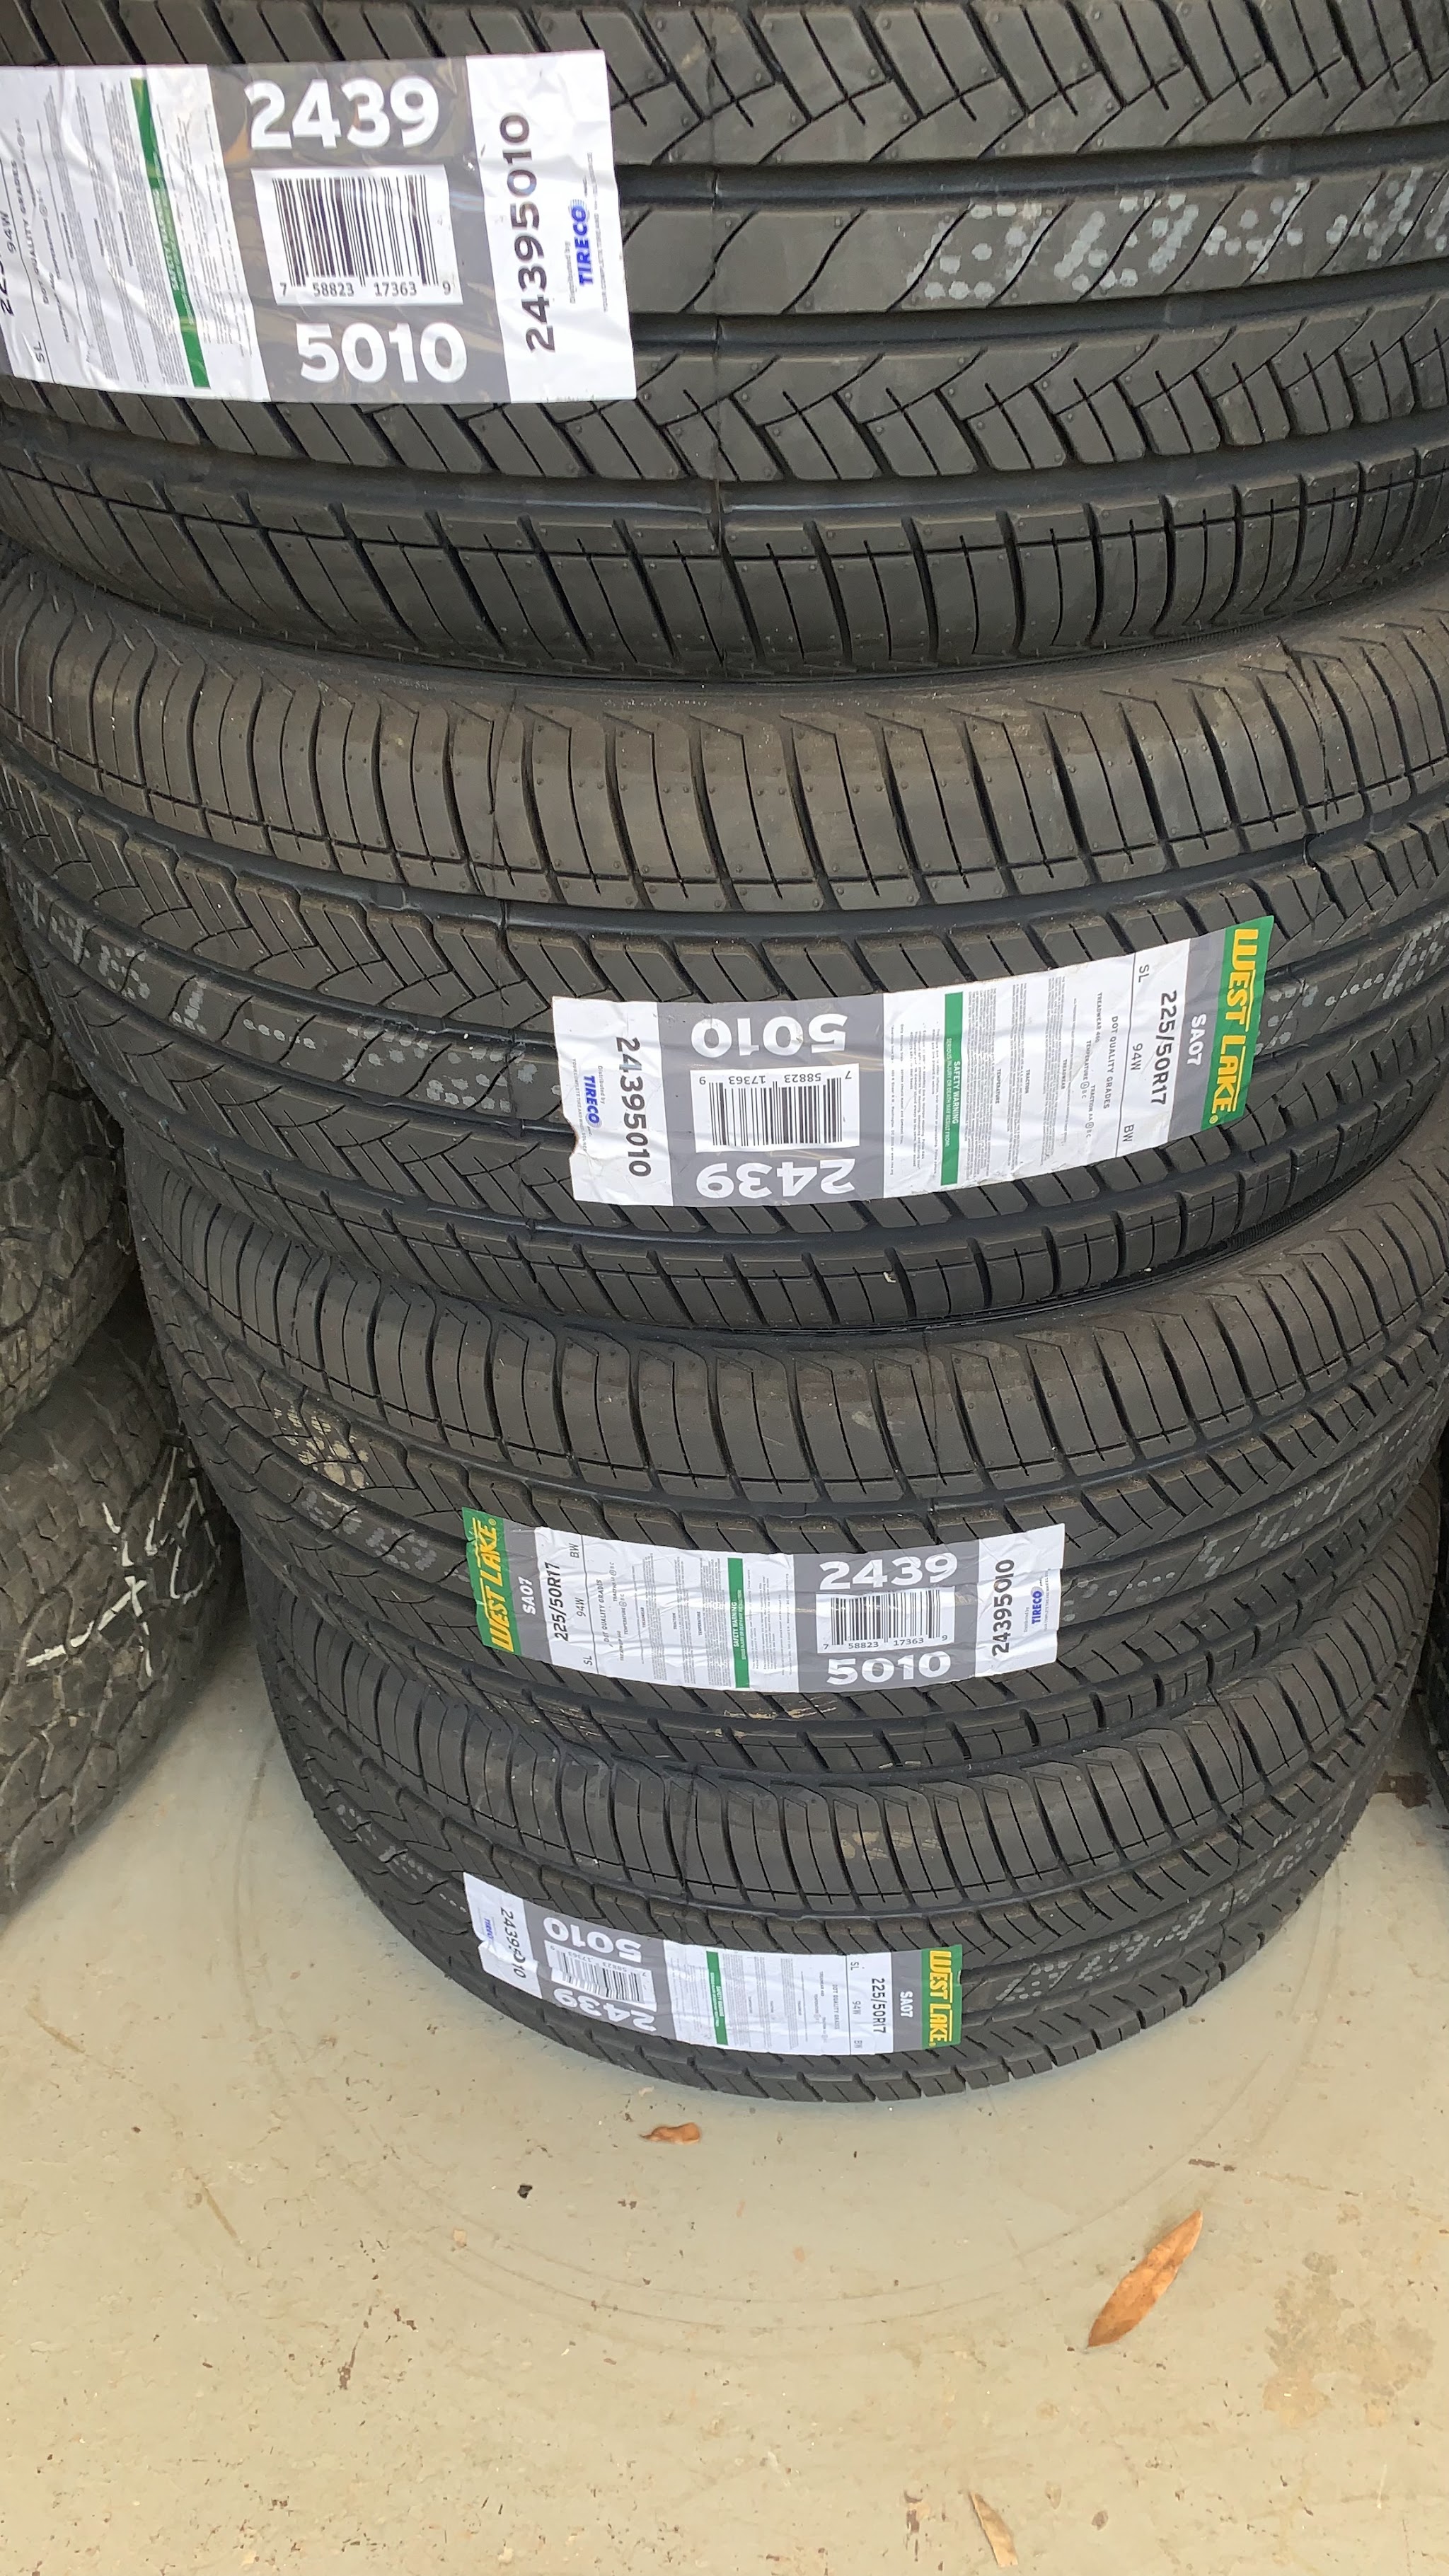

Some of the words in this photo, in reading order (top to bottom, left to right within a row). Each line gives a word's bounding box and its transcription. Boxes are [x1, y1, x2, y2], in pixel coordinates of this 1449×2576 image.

[245, 76, 439, 149] 2439
[11, 158, 27, 214] GRADES
[23, 218, 41, 275] QUALITY
[500, 112, 555, 353] 24395010
[570, 204, 594, 286] TIRECO
[38, 282, 50, 306] DOT
[280, 284, 289, 297] 7
[312, 282, 355, 297] 58823
[374, 281, 417, 297] 17363
[443, 283, 452, 296] 9
[33, 341, 47, 364] SL
[296, 322, 468, 384] 5010
[1138, 964, 1150, 983] SL
[1225, 928, 1259, 1033] WEST
[691, 1014, 848, 1058] 5010
[1107, 1035, 1118, 1073] QUALITY
[1151, 990, 1178, 1106] 225/50R17
[1187, 1014, 1207, 1066] SA07
[844, 1070, 853, 1080] 7
[953, 1061, 962, 1090] SAFETY
[1082, 1040, 1092, 1081] TEMPERATURE
[1131, 1043, 1144, 1071] 94W
[1213, 1034, 1247, 1114] LAKE
[699, 1075, 706, 1085] 9
[729, 1075, 766, 1085] 17363
[784, 1072, 821, 1084] 58823
[1103, 1076, 1114, 1109] GRADES
[584, 1075, 600, 1124] TIRECO
[616, 1036, 652, 1177] 24395010
[952, 1090, 960, 1124] WARNING
[1122, 1124, 1135, 1143] BW
[695, 1158, 855, 1199] 2439
[570, 1542, 580, 1559] BW
[819, 1552, 958, 1590] 2439
[518, 1576, 537, 1615] SA07
[545, 1561, 569, 1642] 225/50R17
[576, 1598, 587, 1618] 94W
[991, 1559, 1015, 1657] 24395010
[1031, 1590, 1042, 1624] TIRECO
[480, 1578, 514, 1653] WEST
[599, 1603, 608, 1630] QUALITY
[601, 1630, 610, 1643] DOT
[848, 1640, 879, 1649] 58823
[893, 1637, 924, 1646] 17363
[584, 1656, 593, 1666] SL
[826, 1651, 952, 1685] 5010
[543, 1917, 642, 1963] 5010
[850, 1960, 860, 1971] SL
[929, 1950, 953, 2004] WEST
[553, 1988, 657, 2032] 2439
[851, 2000, 861, 2015] 94W
[871, 1978, 887, 2034] 225/50R17
[899, 1991, 913, 2018] SA07
[929, 2004, 953, 2043] LAKE
[853, 2040, 862, 2049] BW
